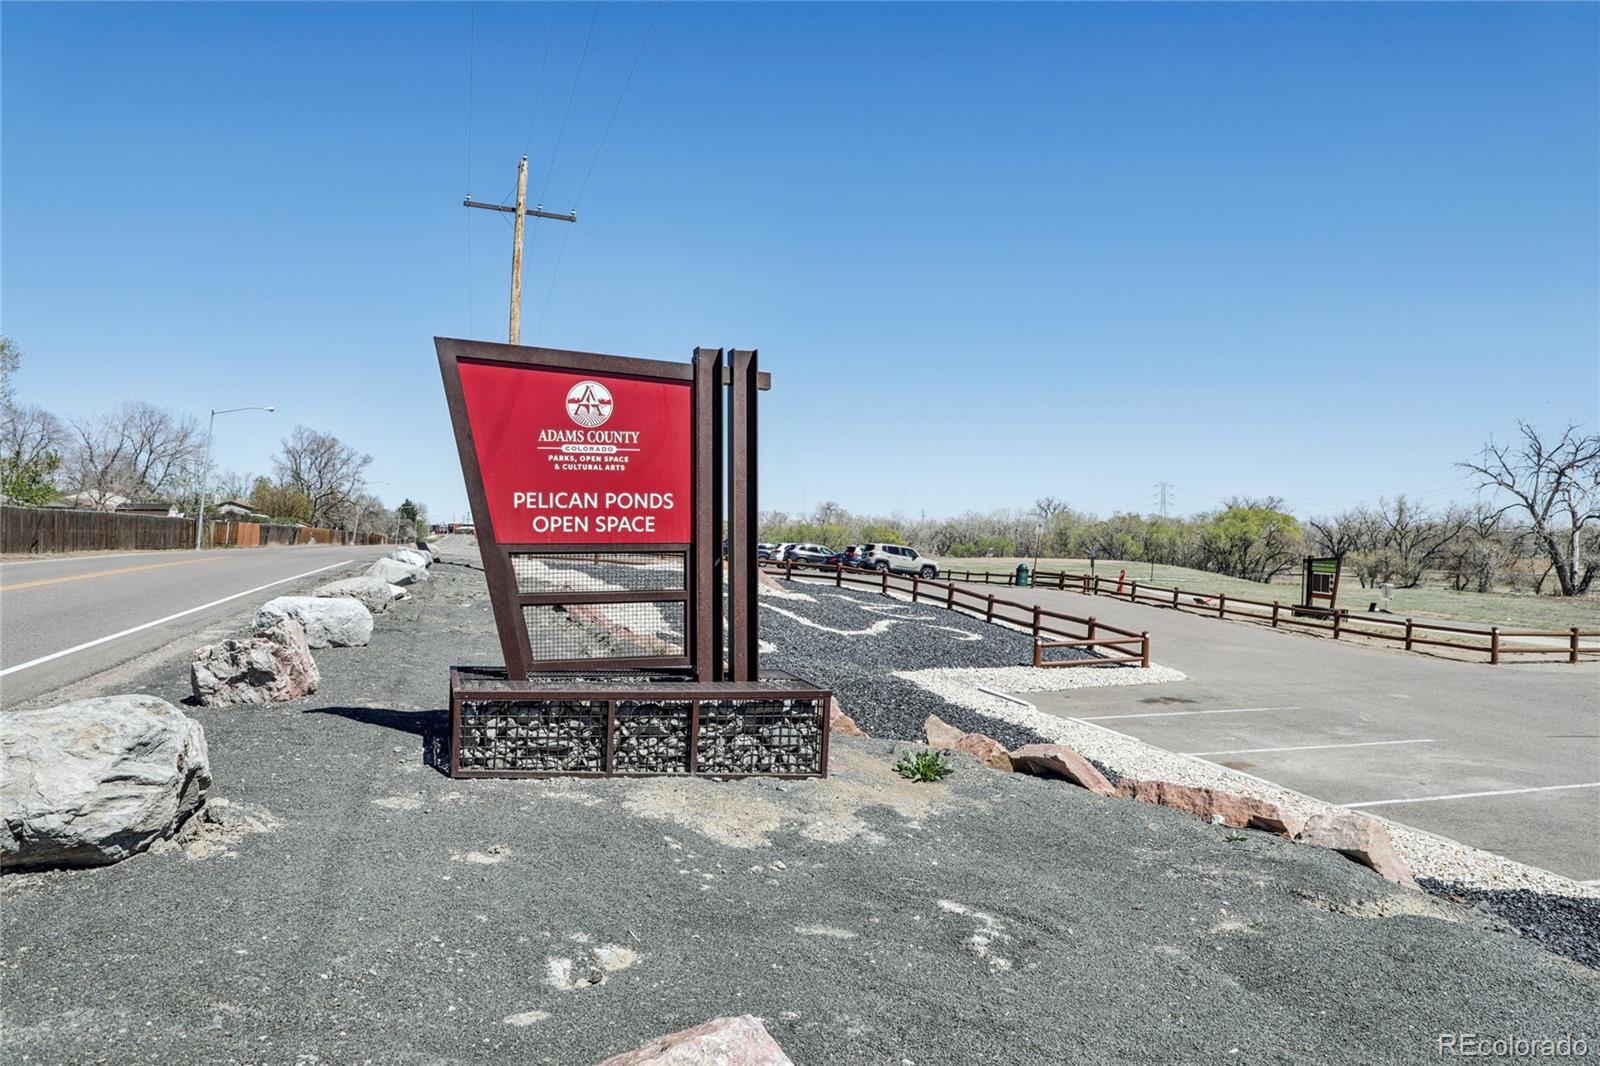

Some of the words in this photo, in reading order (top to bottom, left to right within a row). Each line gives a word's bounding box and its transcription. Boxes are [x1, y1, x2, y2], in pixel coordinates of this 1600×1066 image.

[538, 429, 585, 443] ADAMS
[587, 430, 640, 444] COUNTY
[564, 445, 614, 453] COLORADO
[548, 455, 578, 463] PARKS,
[562, 463, 603, 471] CULTURAL
[513, 492, 598, 509] PELICAN
[605, 492, 674, 509] PONDS
[532, 516, 588, 533] OPEN
[595, 516, 656, 533] SPACE
